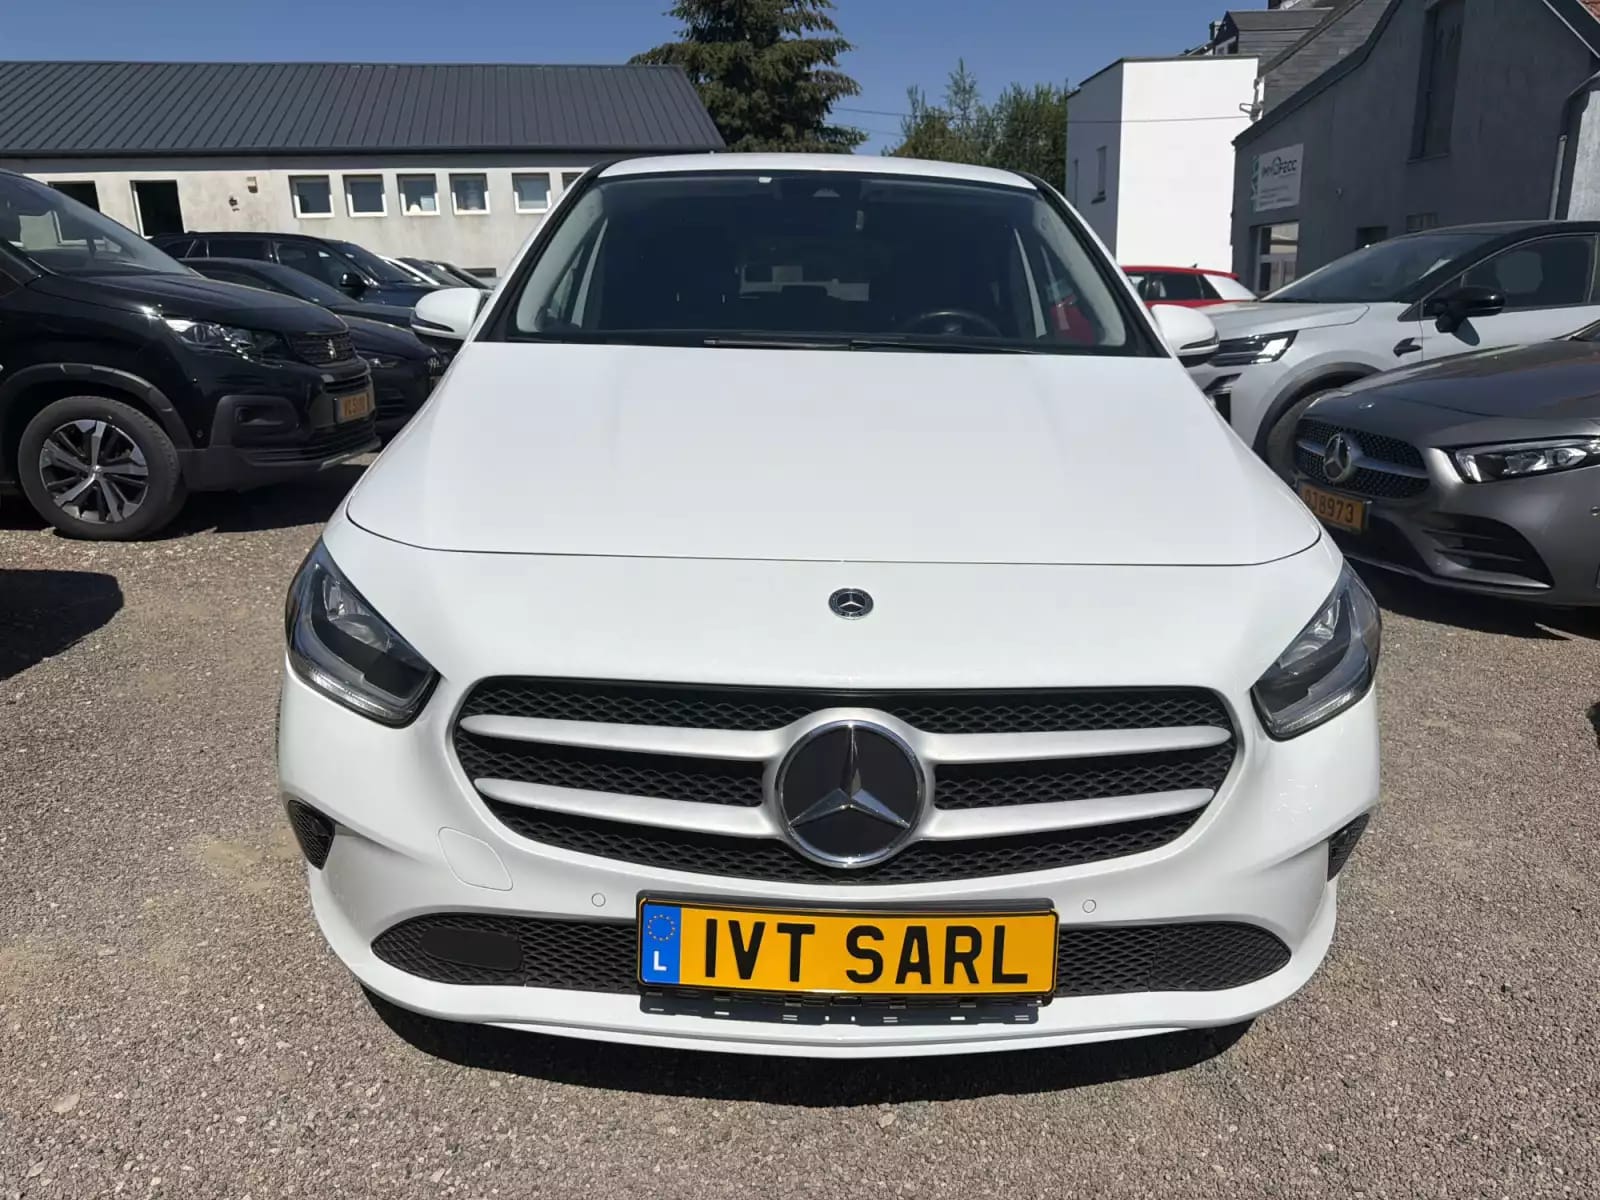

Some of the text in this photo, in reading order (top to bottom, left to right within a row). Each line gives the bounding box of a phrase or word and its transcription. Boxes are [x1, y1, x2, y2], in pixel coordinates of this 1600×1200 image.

[653, 950, 667, 972] L
[704, 918, 1029, 985] IVT SARL
